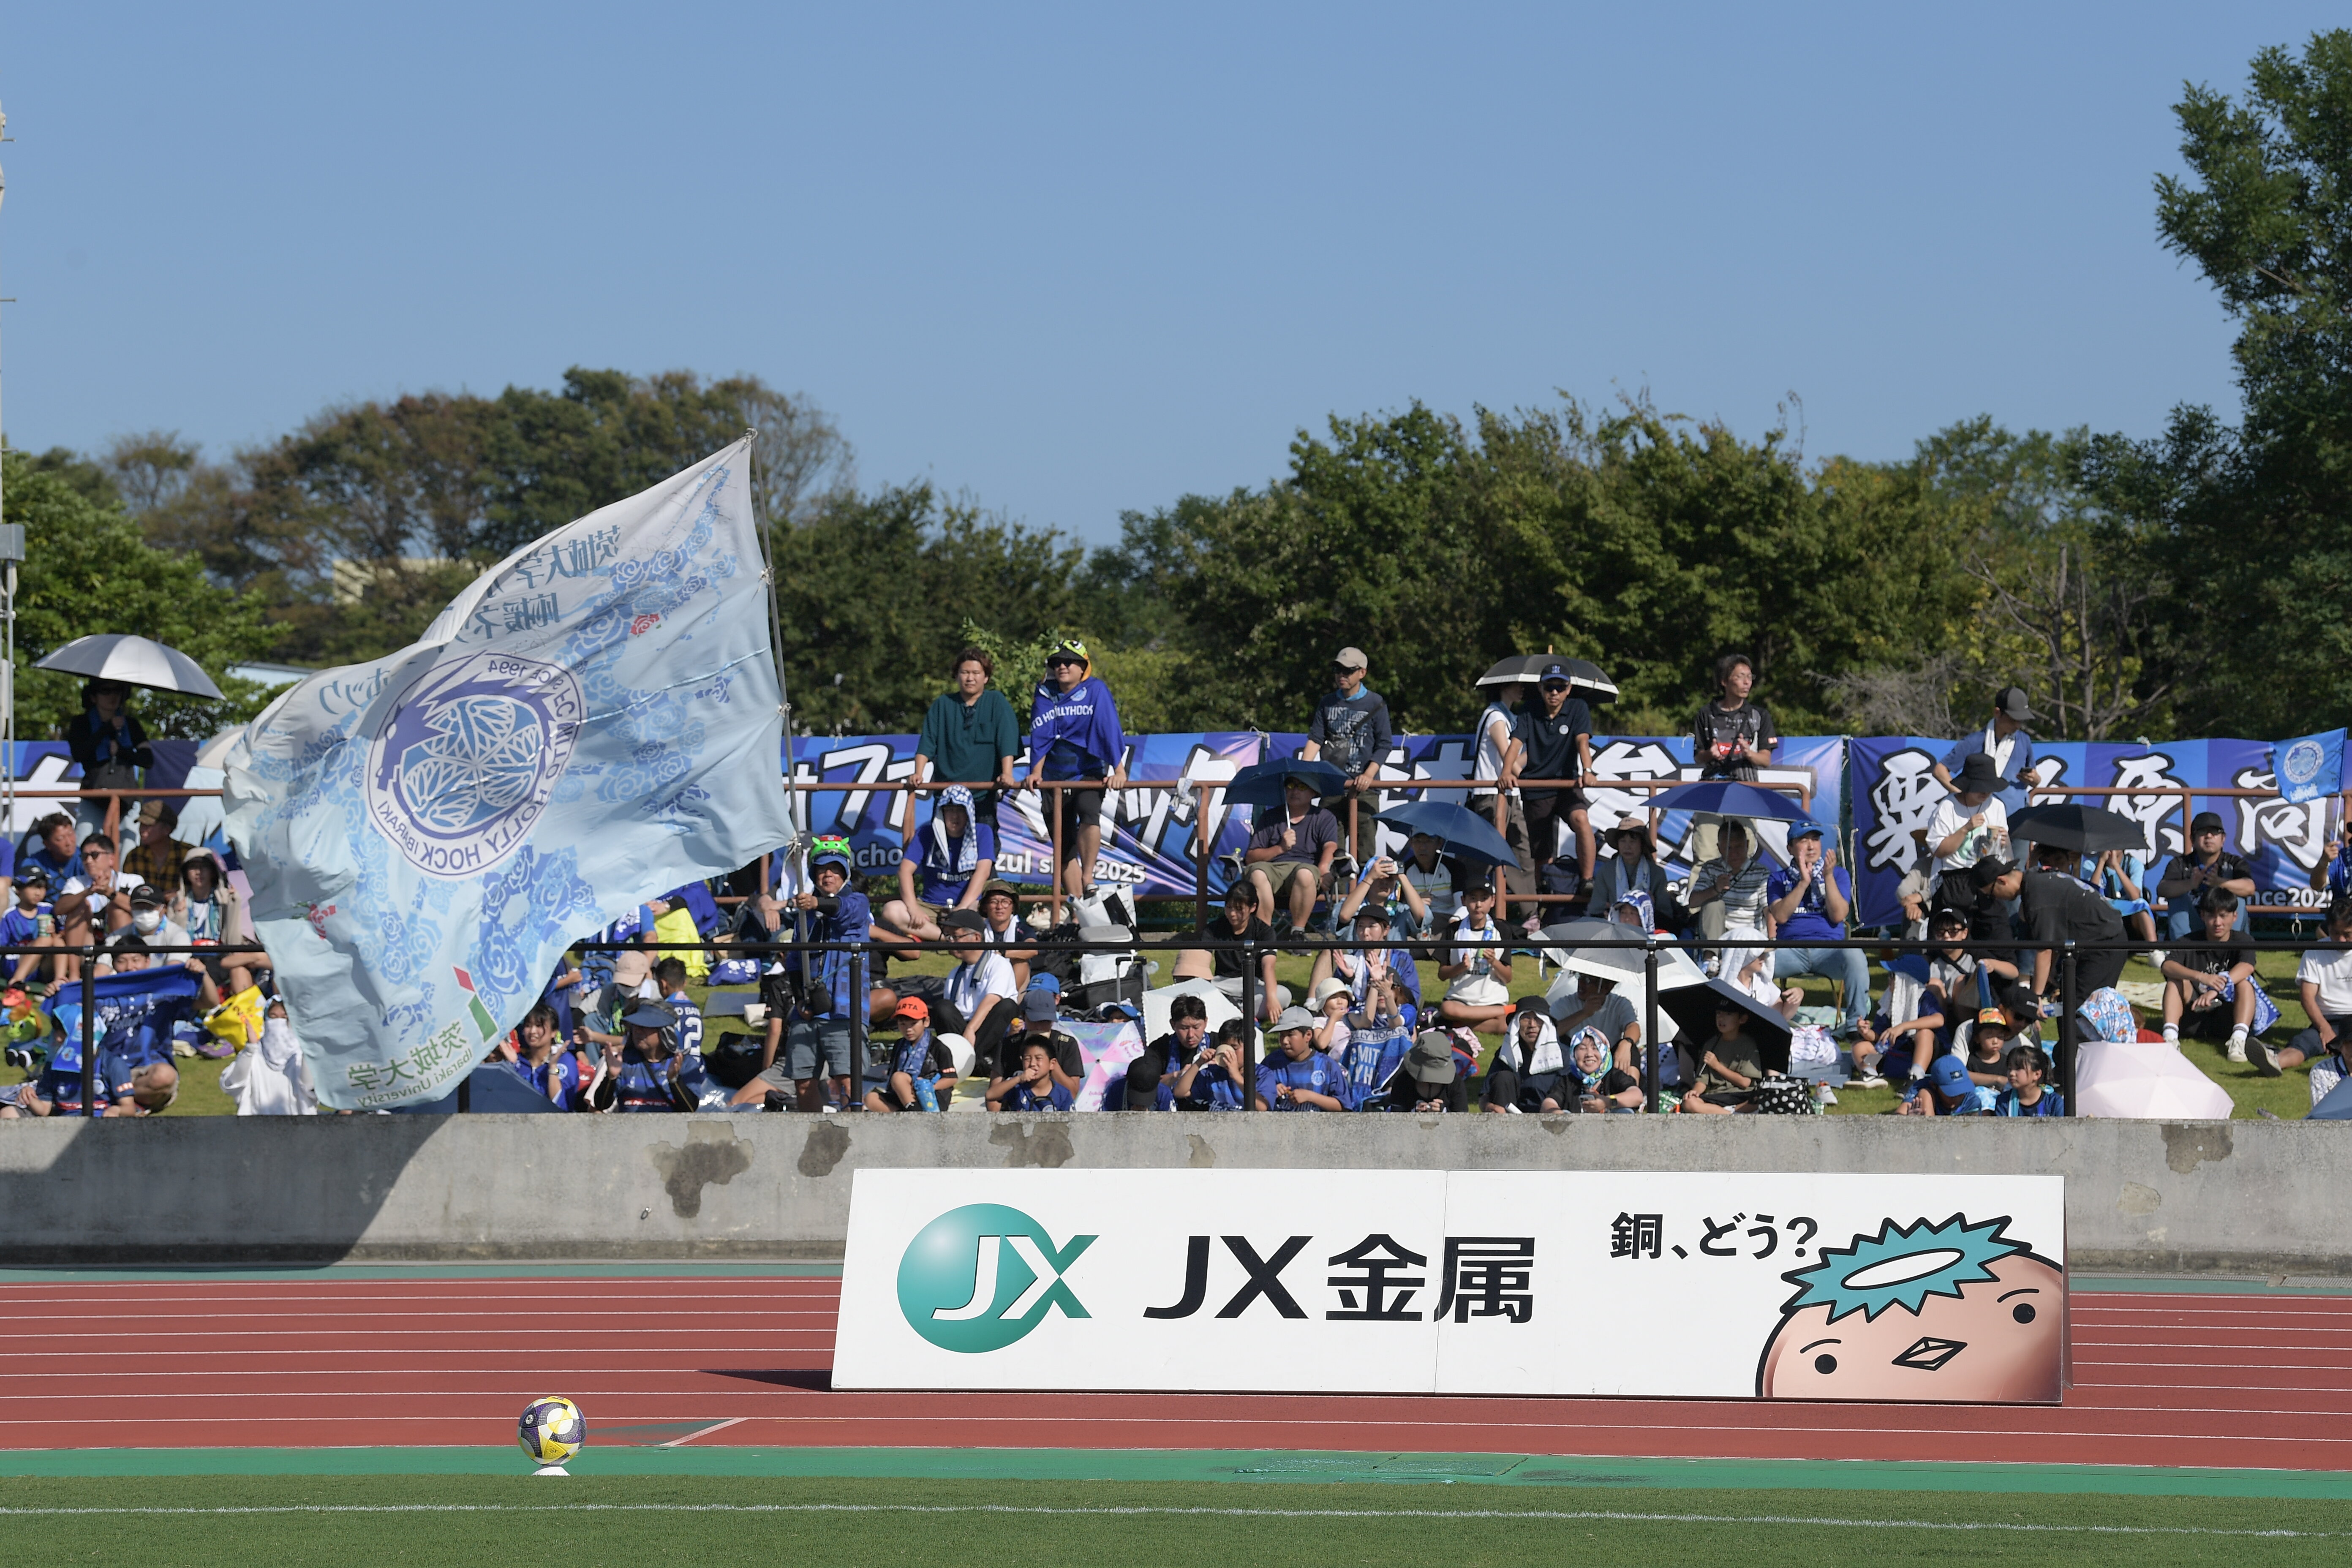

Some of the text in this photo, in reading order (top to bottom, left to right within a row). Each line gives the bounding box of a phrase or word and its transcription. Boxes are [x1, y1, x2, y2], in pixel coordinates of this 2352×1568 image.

[931, 1234, 1100, 1320] JX
[1142, 1233, 1535, 1324] JX金属
[1609, 1211, 1818, 1260] 銅、どう?
